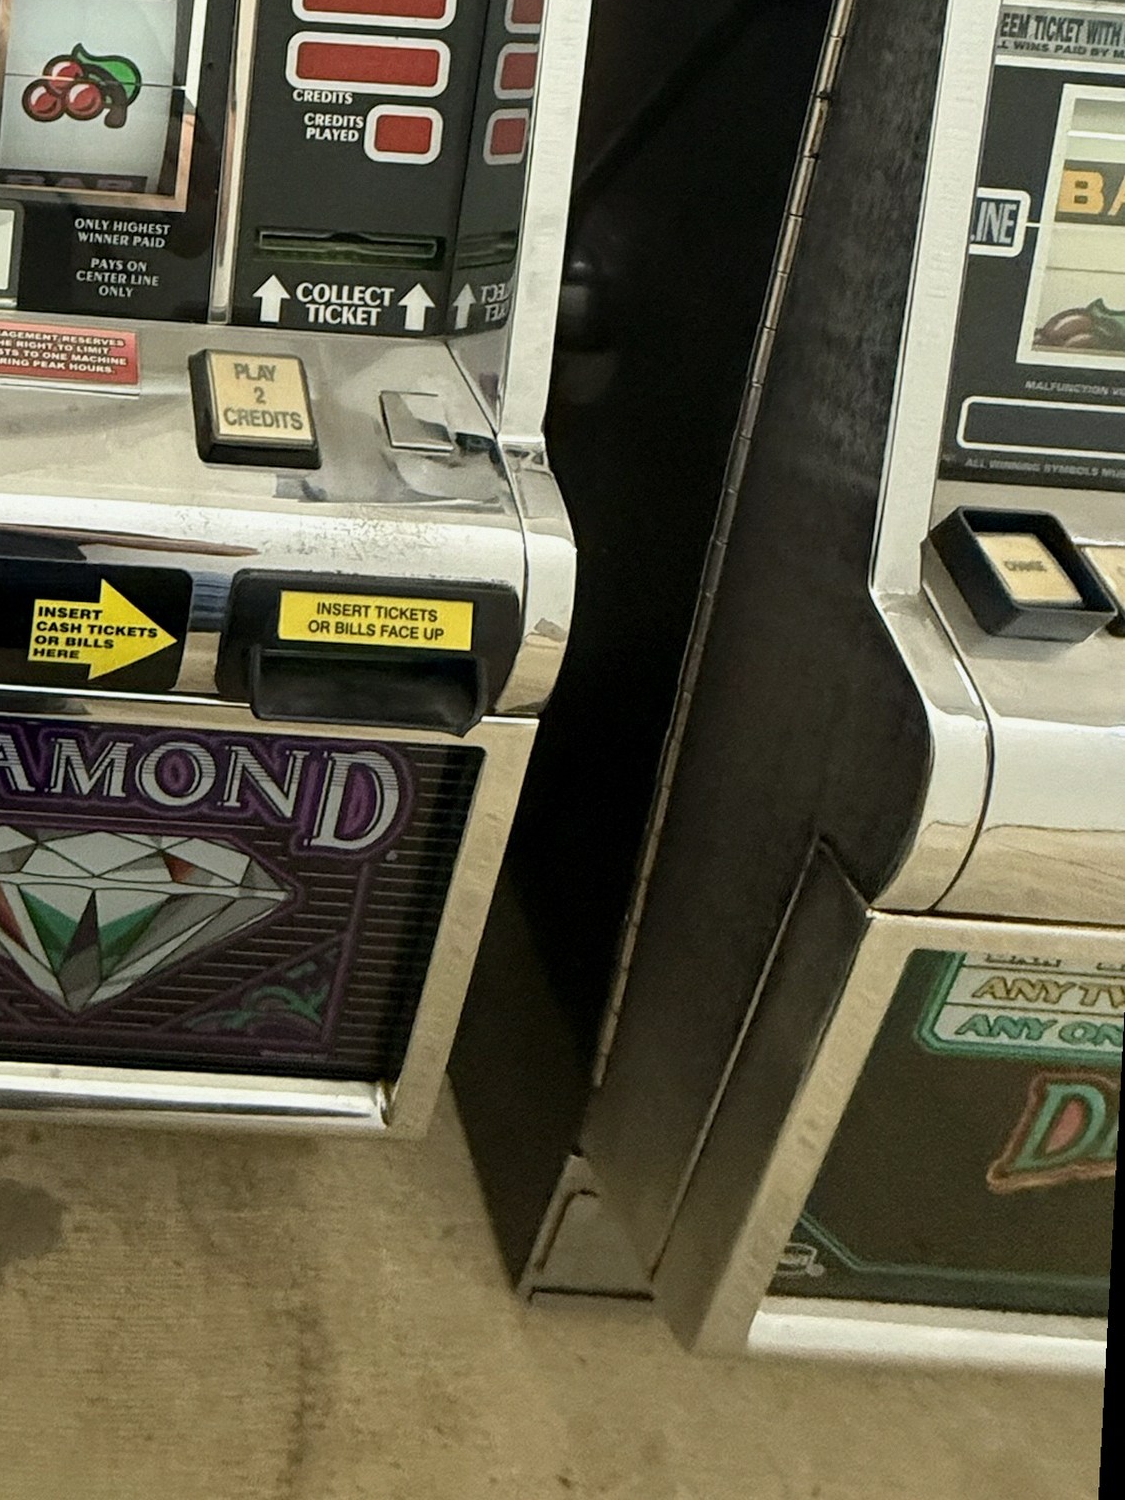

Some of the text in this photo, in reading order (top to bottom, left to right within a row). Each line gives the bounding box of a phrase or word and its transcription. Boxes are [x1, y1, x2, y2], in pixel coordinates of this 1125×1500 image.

[1035, 15, 1123, 47] TICKET WITH
[1013, 41, 1050, 52] WINS
[1055, 44, 1087, 55] PAID
[293, 89, 353, 105] CREDITS
[304, 112, 364, 129] CREDITS
[306, 126, 359, 142] PLAYED
[75, 218, 171, 235] ONLY HIGHEST
[77, 232, 165, 248] WINNER PAID
[91, 258, 147, 272] PAYS ON
[76, 270, 159, 287] CENTER LINE
[98, 285, 133, 297] ONLY
[296, 282, 395, 307] COLLECT
[306, 303, 382, 326] TICKET
[16, 340, 53, 351] RIGHT
[76, 346, 111, 355] LIMIT
[61, 334, 124, 347] RESERVES
[33, 360, 66, 370] PEAK
[69, 364, 115, 374] HOURS.
[42, 351, 68, 361] ONE
[71, 354, 127, 366] MACHINE
[234, 363, 276, 382] PLAY
[253, 387, 266, 405] 2
[223, 407, 303, 431] CREDITS
[38, 605, 103, 620] INSERT
[316, 602, 438, 623] INSERT TICKETS
[36, 621, 158, 638] CASH TICKETS
[308, 619, 445, 641] OR BILLS FACE UP
[34, 635, 115, 649] OR BILLS
[33, 648, 81, 659] HERE
[972, 975, 1075, 1002] ANY
[955, 1013, 1057, 1041] ANY
